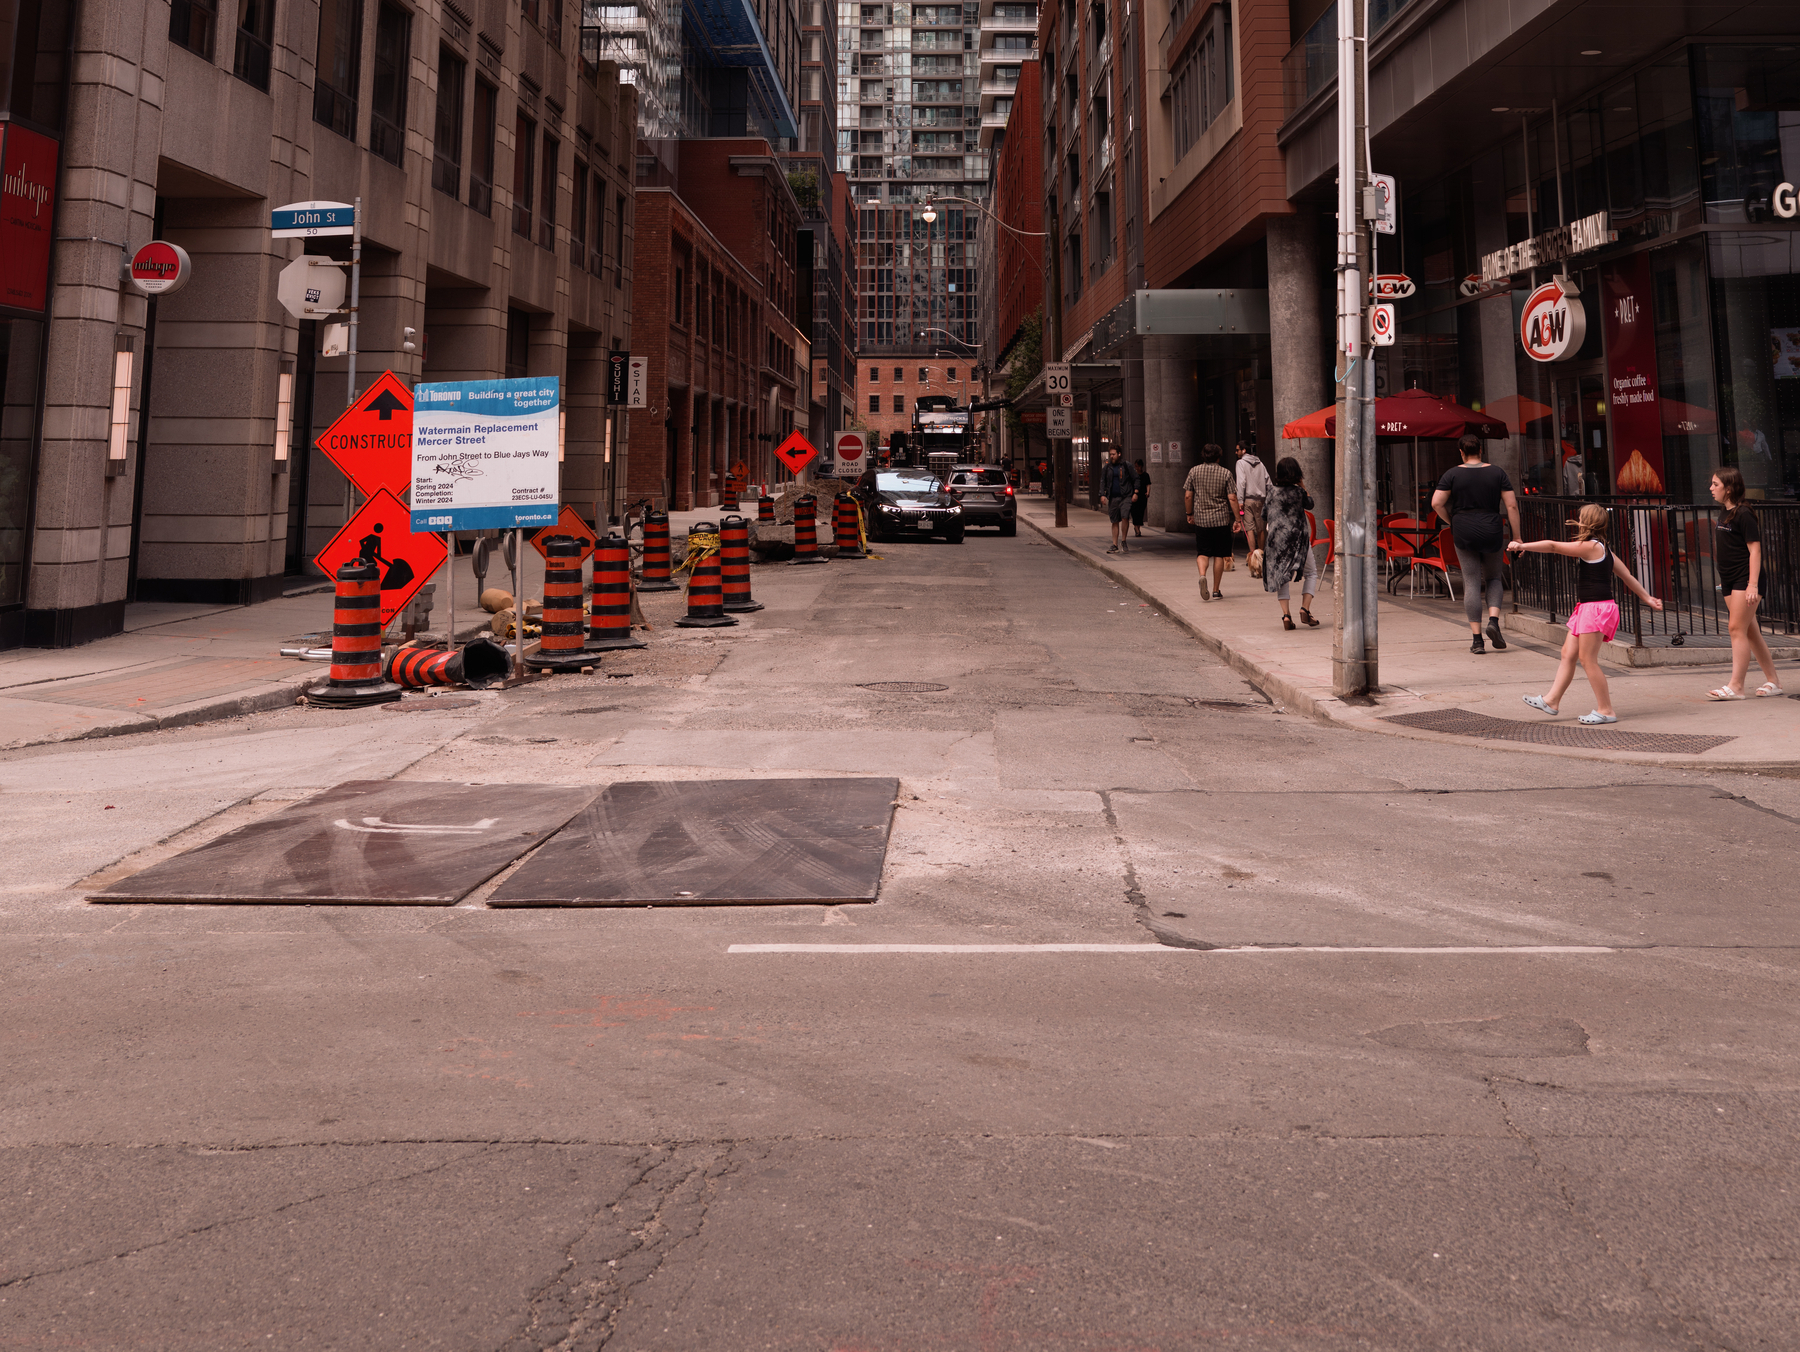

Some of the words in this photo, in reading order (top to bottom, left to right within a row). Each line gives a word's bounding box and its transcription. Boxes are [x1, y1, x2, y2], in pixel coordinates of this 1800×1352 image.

[4, 162, 52, 219] milagro
[292, 212, 320, 224] John
[326, 212, 336, 223] St
[1482, 250, 1505, 282] HOME
[1504, 245, 1519, 275] OF
[1517, 238, 1537, 270] THE
[1536, 226, 1572, 264] BURGER
[1571, 211, 1608, 253] FAMILY
[134, 257, 176, 277] milagro
[1619, 296, 1634, 324] PRET
[1529, 308, 1566, 349] A&W
[1048, 376, 1068, 389] 30
[1613, 376, 1631, 392] Organic
[1632, 374, 1646, 387] coffee
[430, 390, 461, 402] TORONTO
[468, 391, 504, 400] Building
[514, 390, 536, 400] great
[539, 389, 555, 398] city
[1612, 393, 1629, 406] freshly
[1629, 391, 1642, 403] made
[1643, 390, 1654, 402] food
[514, 398, 552, 408] together
[1053, 409, 1065, 417] ONE
[418, 426, 471, 436] Watermain
[474, 423, 538, 434] Replacement
[1048, 428, 1070, 436] BEGINS
[1387, 422, 1402, 432] PRET
[417, 437, 452, 446] Mercer
[456, 435, 486, 445] Street
[459, 452, 482, 460] Street
[494, 451, 511, 459] Blue
[512, 450, 530, 459] Jays
[532, 450, 549, 459] Way
